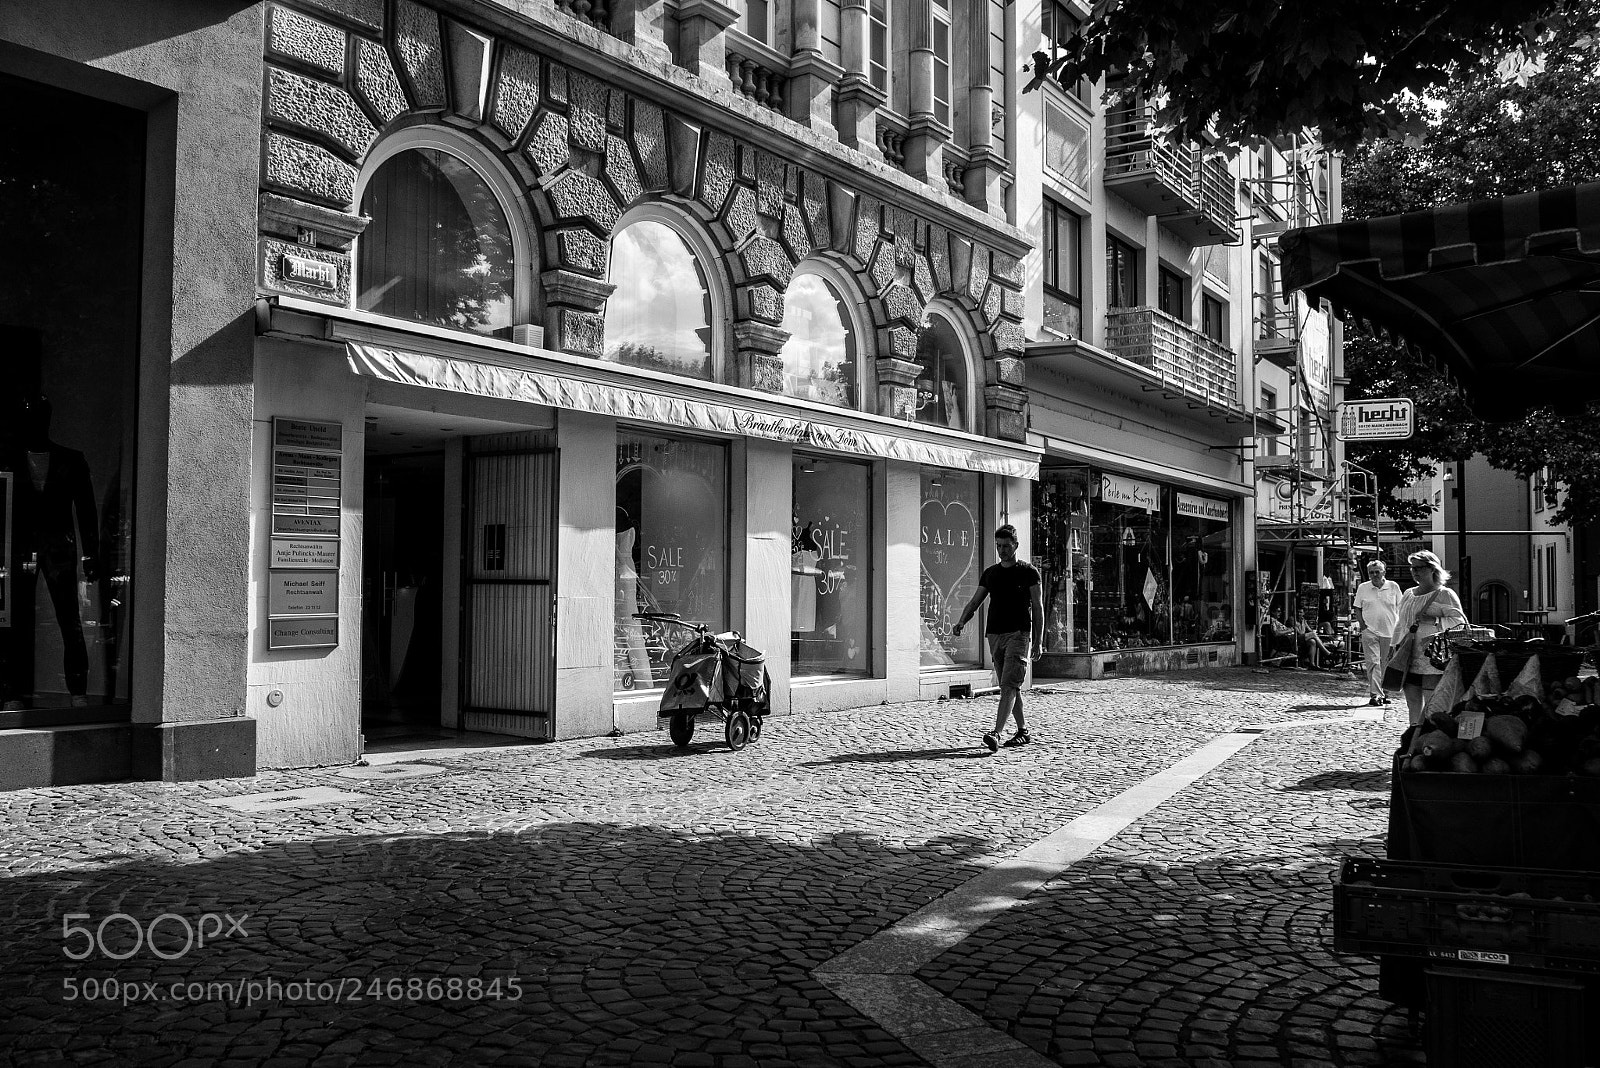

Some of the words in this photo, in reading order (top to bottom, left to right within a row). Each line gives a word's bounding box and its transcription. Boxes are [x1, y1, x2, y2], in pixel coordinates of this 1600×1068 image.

[301, 228, 314, 245] 31
[1358, 404, 1407, 423] hecht
[740, 412, 811, 441] Brautboutiq
[816, 431, 831, 442] am
[836, 428, 858, 447] Dom
[812, 528, 848, 562] SALE
[920, 526, 969, 547] SALE
[648, 546, 684, 569] SALE
[658, 570, 677, 584] 30%
